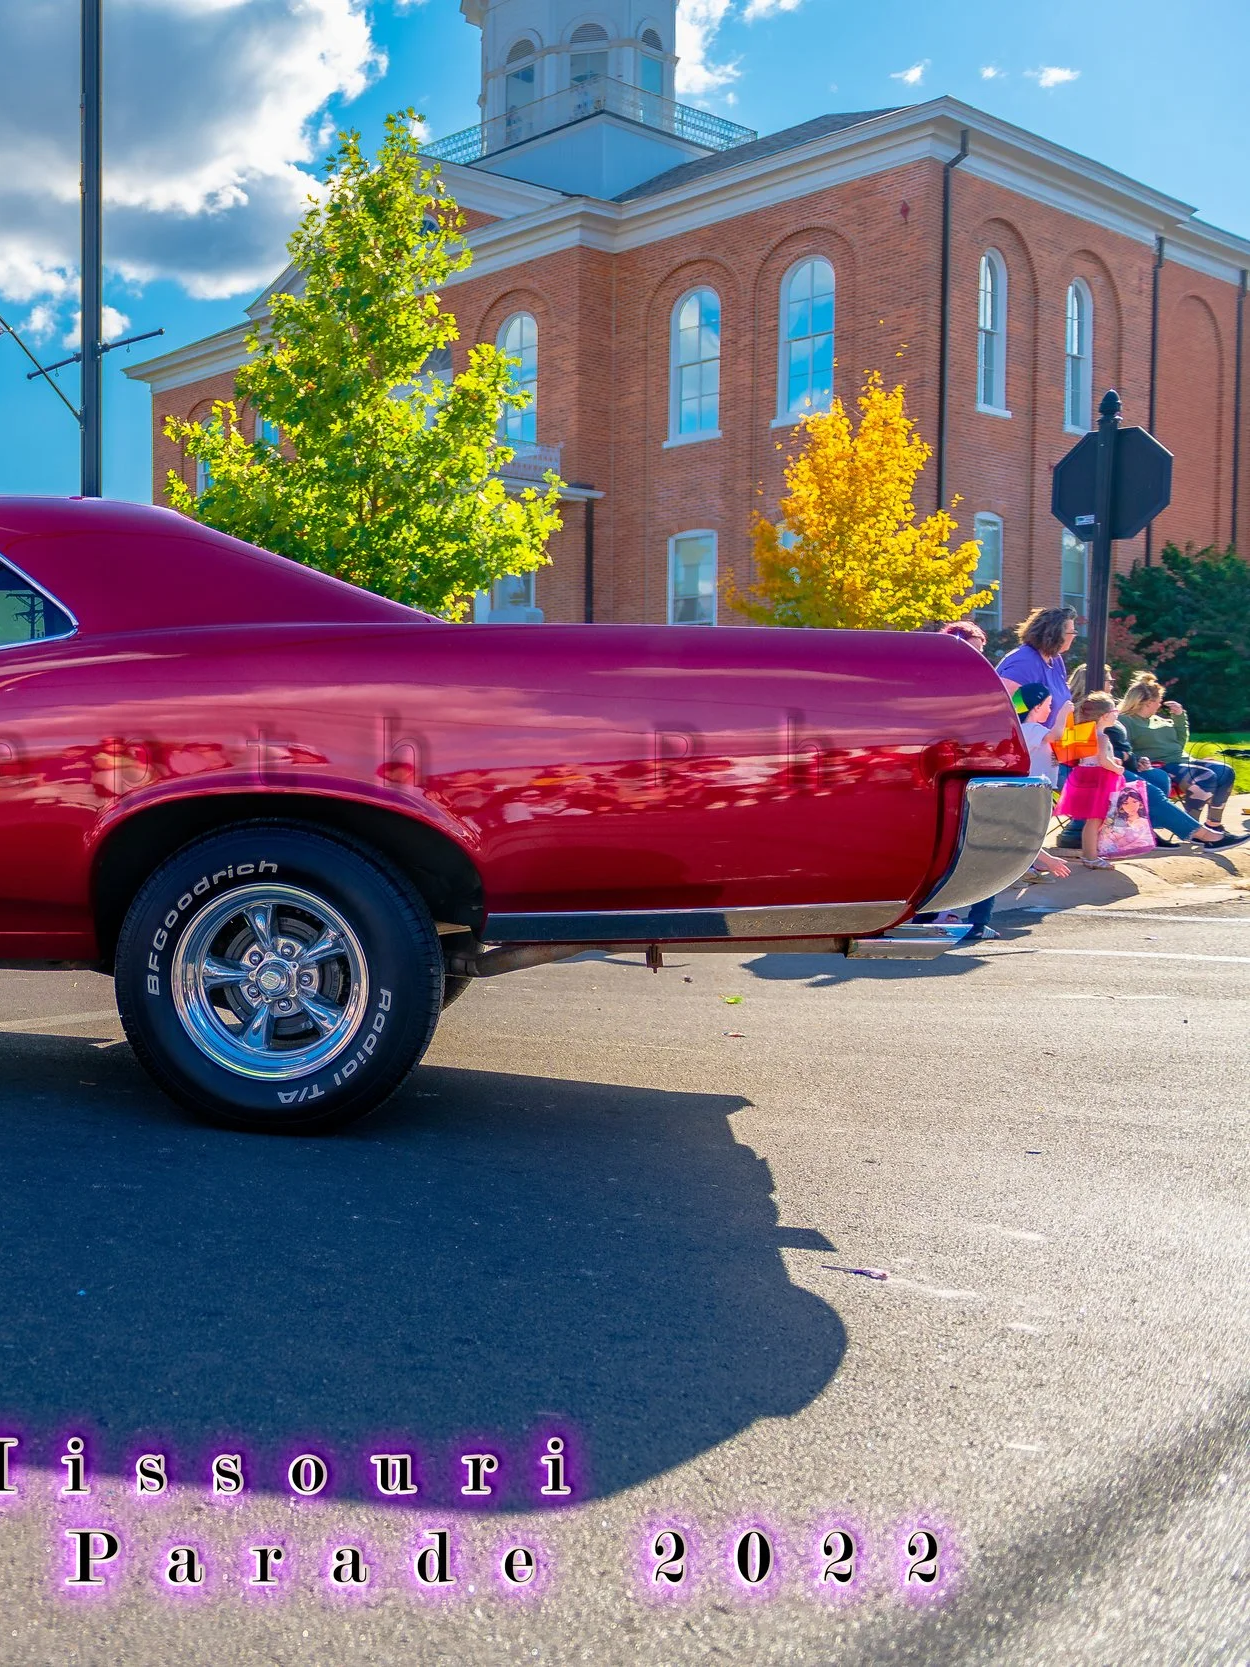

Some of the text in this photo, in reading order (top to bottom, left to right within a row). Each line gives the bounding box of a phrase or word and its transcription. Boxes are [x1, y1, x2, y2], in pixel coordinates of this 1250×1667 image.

[146, 860, 279, 996] BFGoodrich
[276, 987, 393, 1105] Radial T/A
